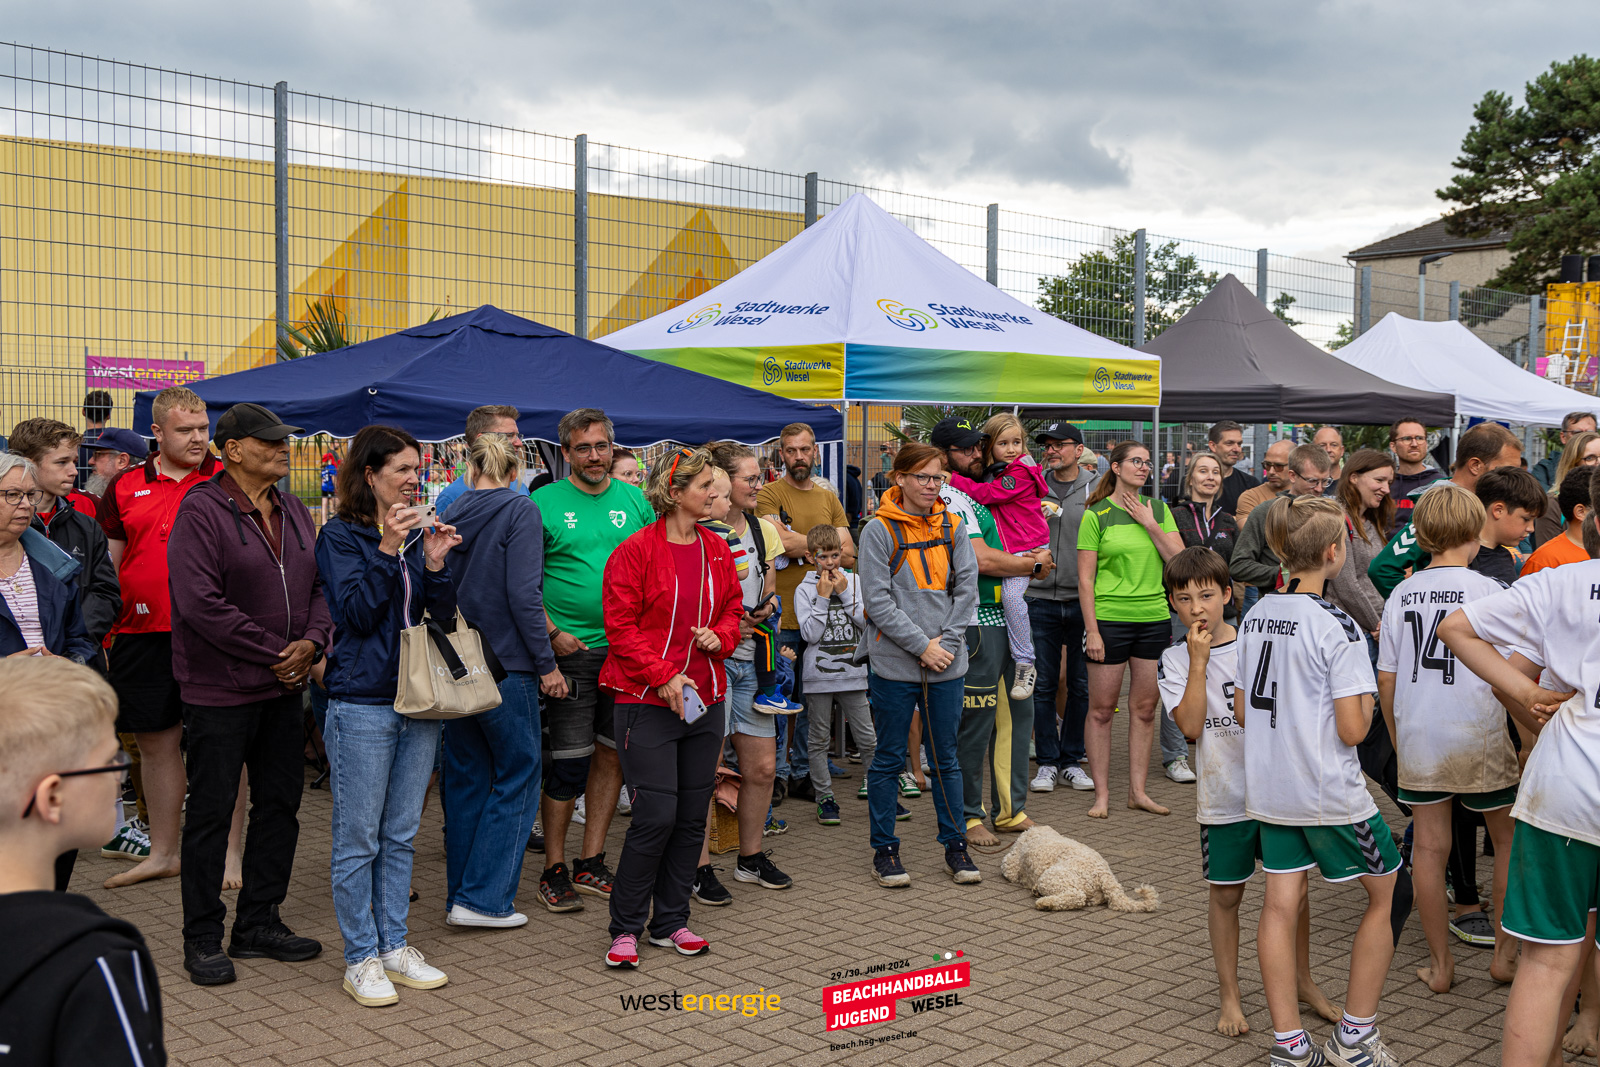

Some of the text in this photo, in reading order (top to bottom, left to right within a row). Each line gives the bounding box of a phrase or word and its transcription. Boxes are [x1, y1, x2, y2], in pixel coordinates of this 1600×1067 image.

[728, 300, 830, 315] Stadtwerke
[928, 303, 1033, 325] Stadtwerke
[713, 314, 771, 326] Wesel
[941, 317, 1005, 332] Wesel
[784, 359, 831, 370] Stadtwerke
[92, 365, 200, 385] westenergie
[785, 371, 809, 382] Wesel
[1113, 371, 1153, 382] Stadtwerke
[1112, 381, 1136, 390] Wesel
[134, 489, 151, 498] JAKO
[1430, 590, 1465, 604] RHEDE
[136, 603, 150, 615] NA
[1267, 618, 1299, 636] RHEDE
[1404, 609, 1455, 685] 14
[1250, 640, 1277, 729] 4
